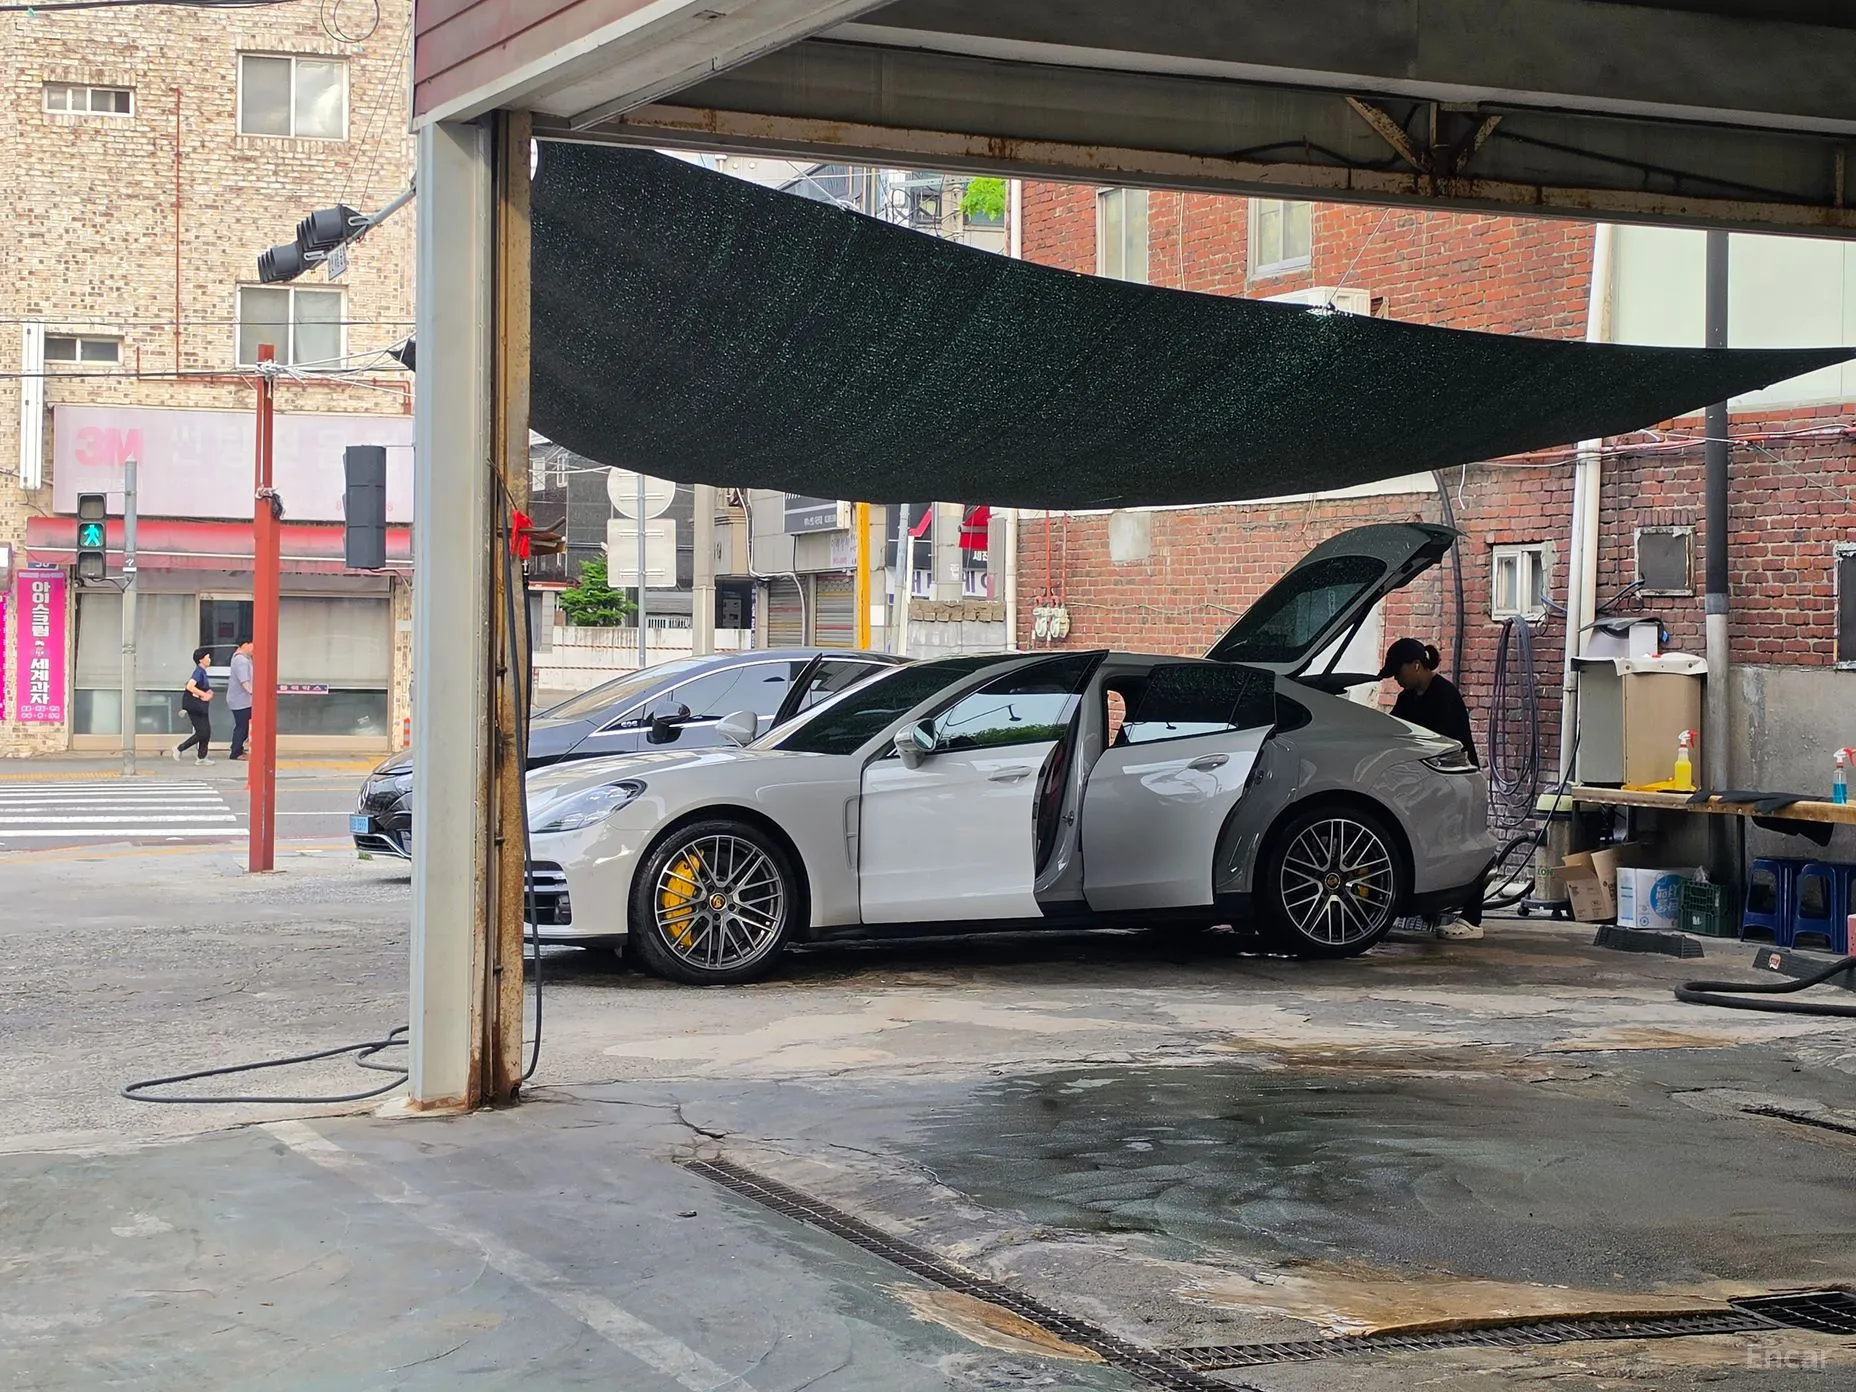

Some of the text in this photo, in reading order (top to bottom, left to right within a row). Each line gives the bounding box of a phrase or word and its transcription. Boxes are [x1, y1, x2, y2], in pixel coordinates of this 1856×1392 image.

[75, 427, 144, 467] 3M
[32, 581, 51, 637] 아이스크림
[30, 658, 50, 705] 세계과자
